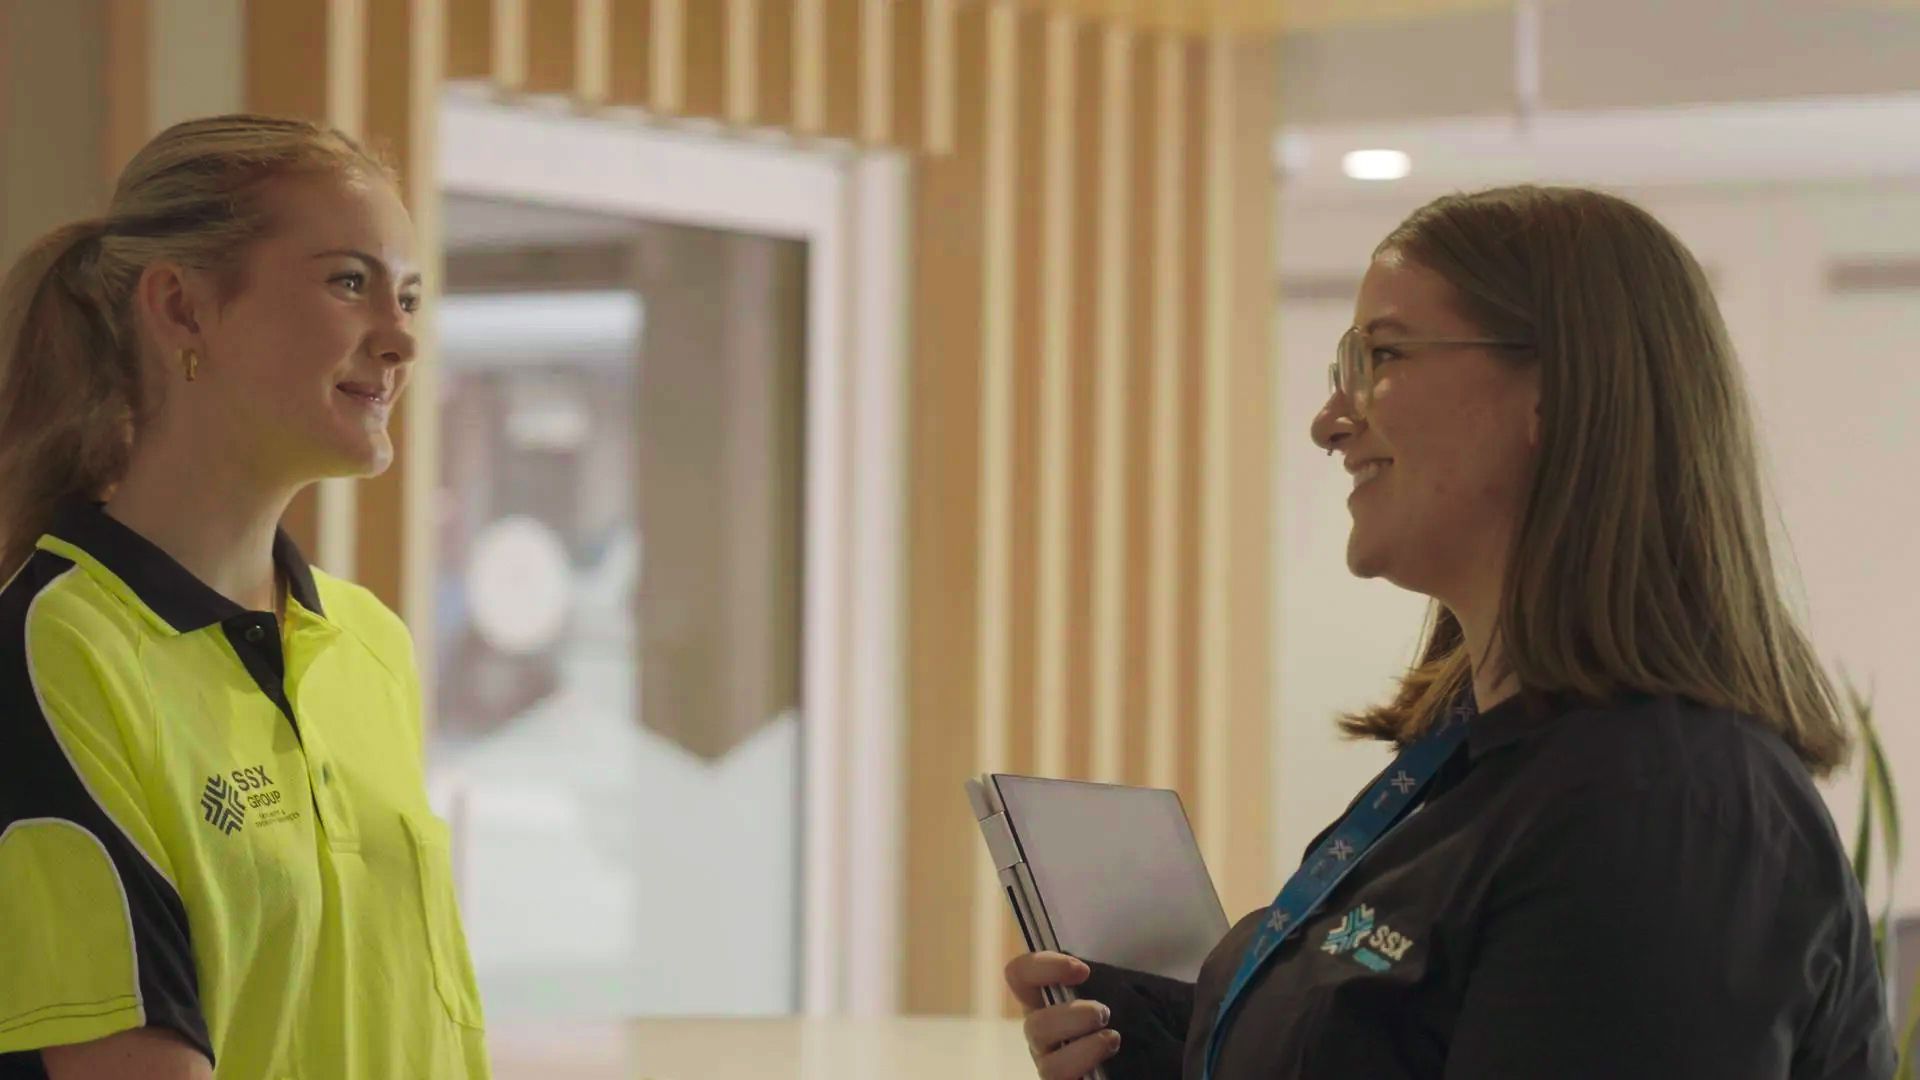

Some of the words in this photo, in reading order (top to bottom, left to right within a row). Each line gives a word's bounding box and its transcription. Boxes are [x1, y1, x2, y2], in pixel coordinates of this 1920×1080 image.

[231, 765, 274, 791] SSX
[247, 790, 281, 808] GROUP
[1369, 925, 1413, 960] SSX
